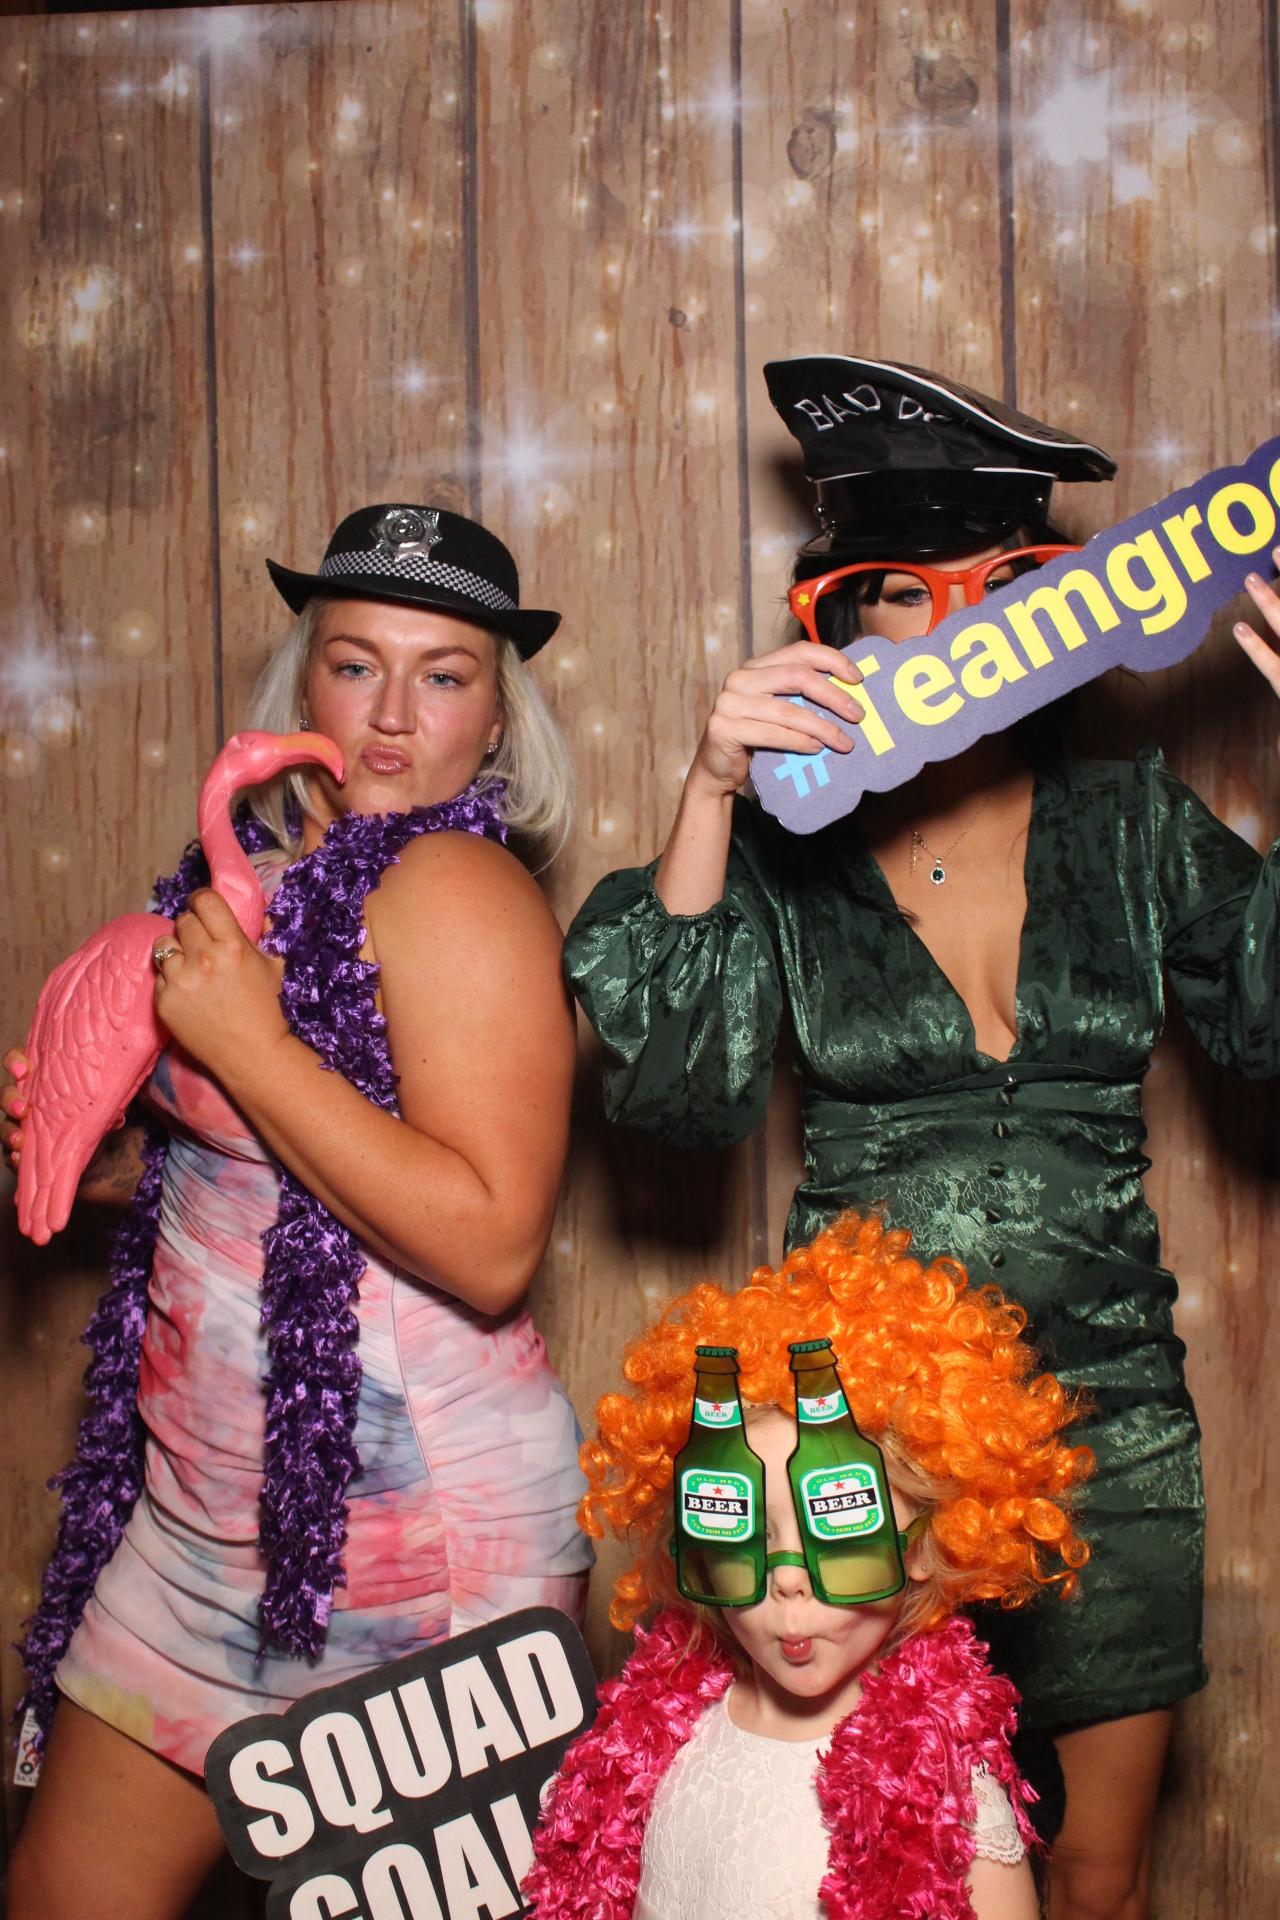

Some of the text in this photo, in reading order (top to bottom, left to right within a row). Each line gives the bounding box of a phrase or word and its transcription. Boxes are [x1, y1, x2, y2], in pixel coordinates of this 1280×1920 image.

[793, 384, 881, 431] BAD
[773, 455, 1280, 798] #Teamgro
[810, 1404, 833, 1414] BEER
[687, 1497, 744, 1514] BEER
[812, 1492, 873, 1513] BEER
[229, 1630, 584, 1858] SQUAD
[289, 1775, 557, 1920] OAL
